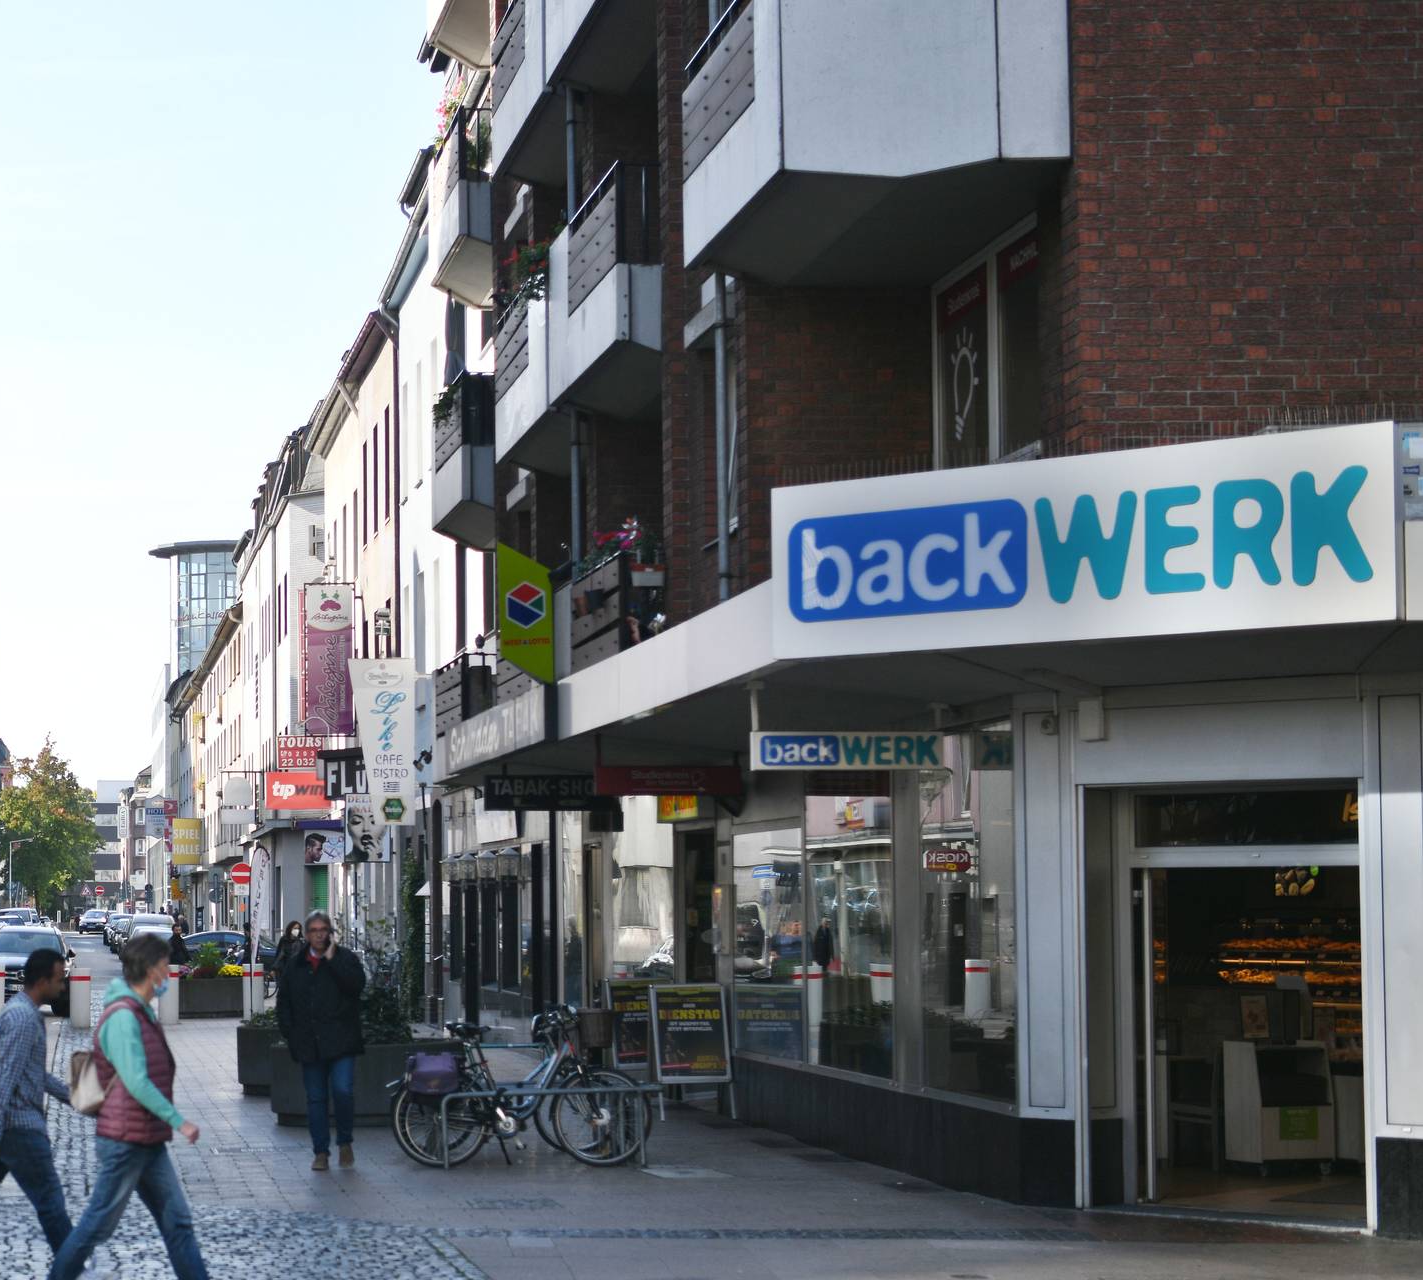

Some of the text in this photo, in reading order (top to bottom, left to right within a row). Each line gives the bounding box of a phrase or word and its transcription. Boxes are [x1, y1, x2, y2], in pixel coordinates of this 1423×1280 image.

[279, 737, 322, 748] TOURS
[375, 754, 403, 767] CAFE
[373, 768, 408, 779] BISTRO
[174, 828, 200, 840] SPIEL
[175, 845, 201, 856] HALLE
[658, 1008, 721, 1020] DIENSTAG
